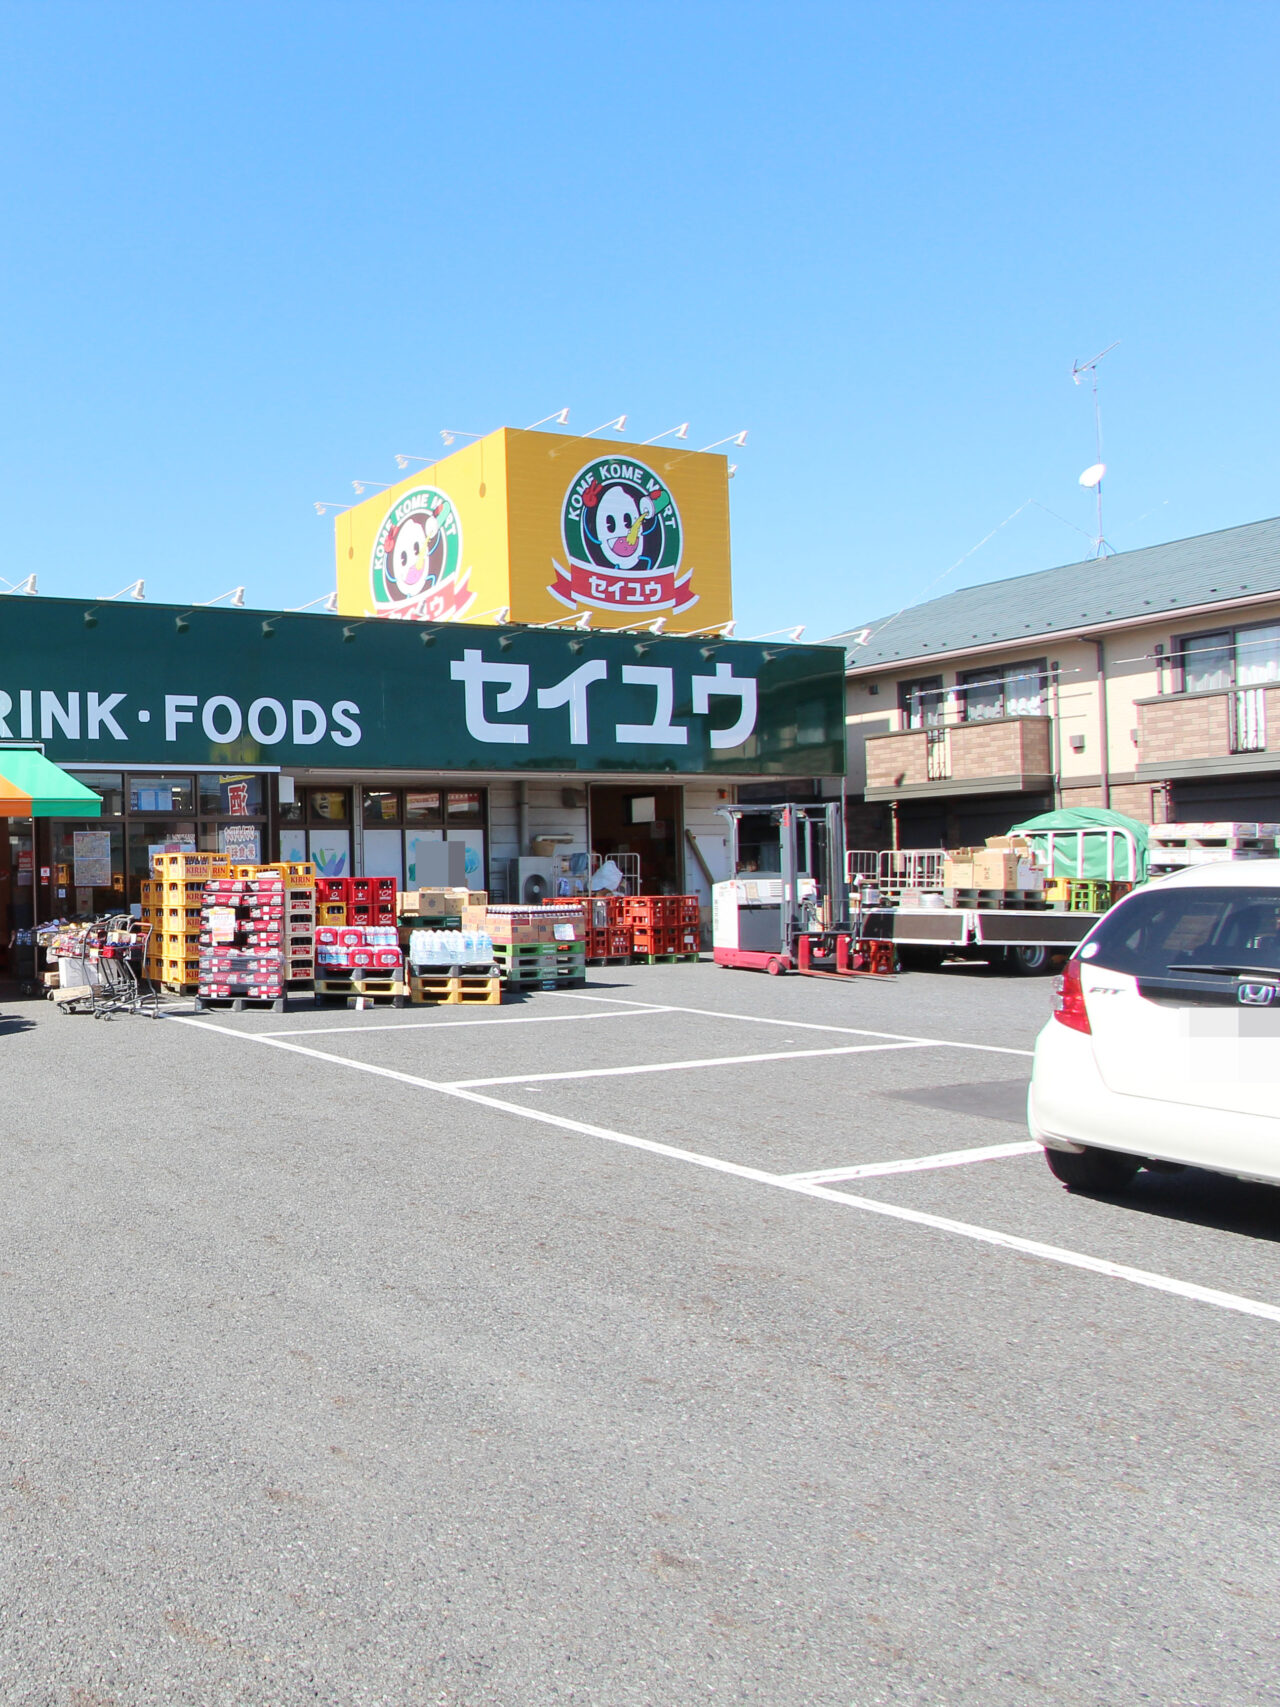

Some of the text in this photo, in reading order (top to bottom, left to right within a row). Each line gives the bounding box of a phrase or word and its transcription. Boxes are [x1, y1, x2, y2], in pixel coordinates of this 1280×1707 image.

[395, 493, 429, 520] KOME
[431, 496, 457, 536] MRT
[599, 464, 643, 484] KOME
[646, 478, 676, 529] MRT
[588, 575, 662, 602] セイユウ
[450, 649, 757, 749] セイユウ
[212, 866, 226, 874] RIN
